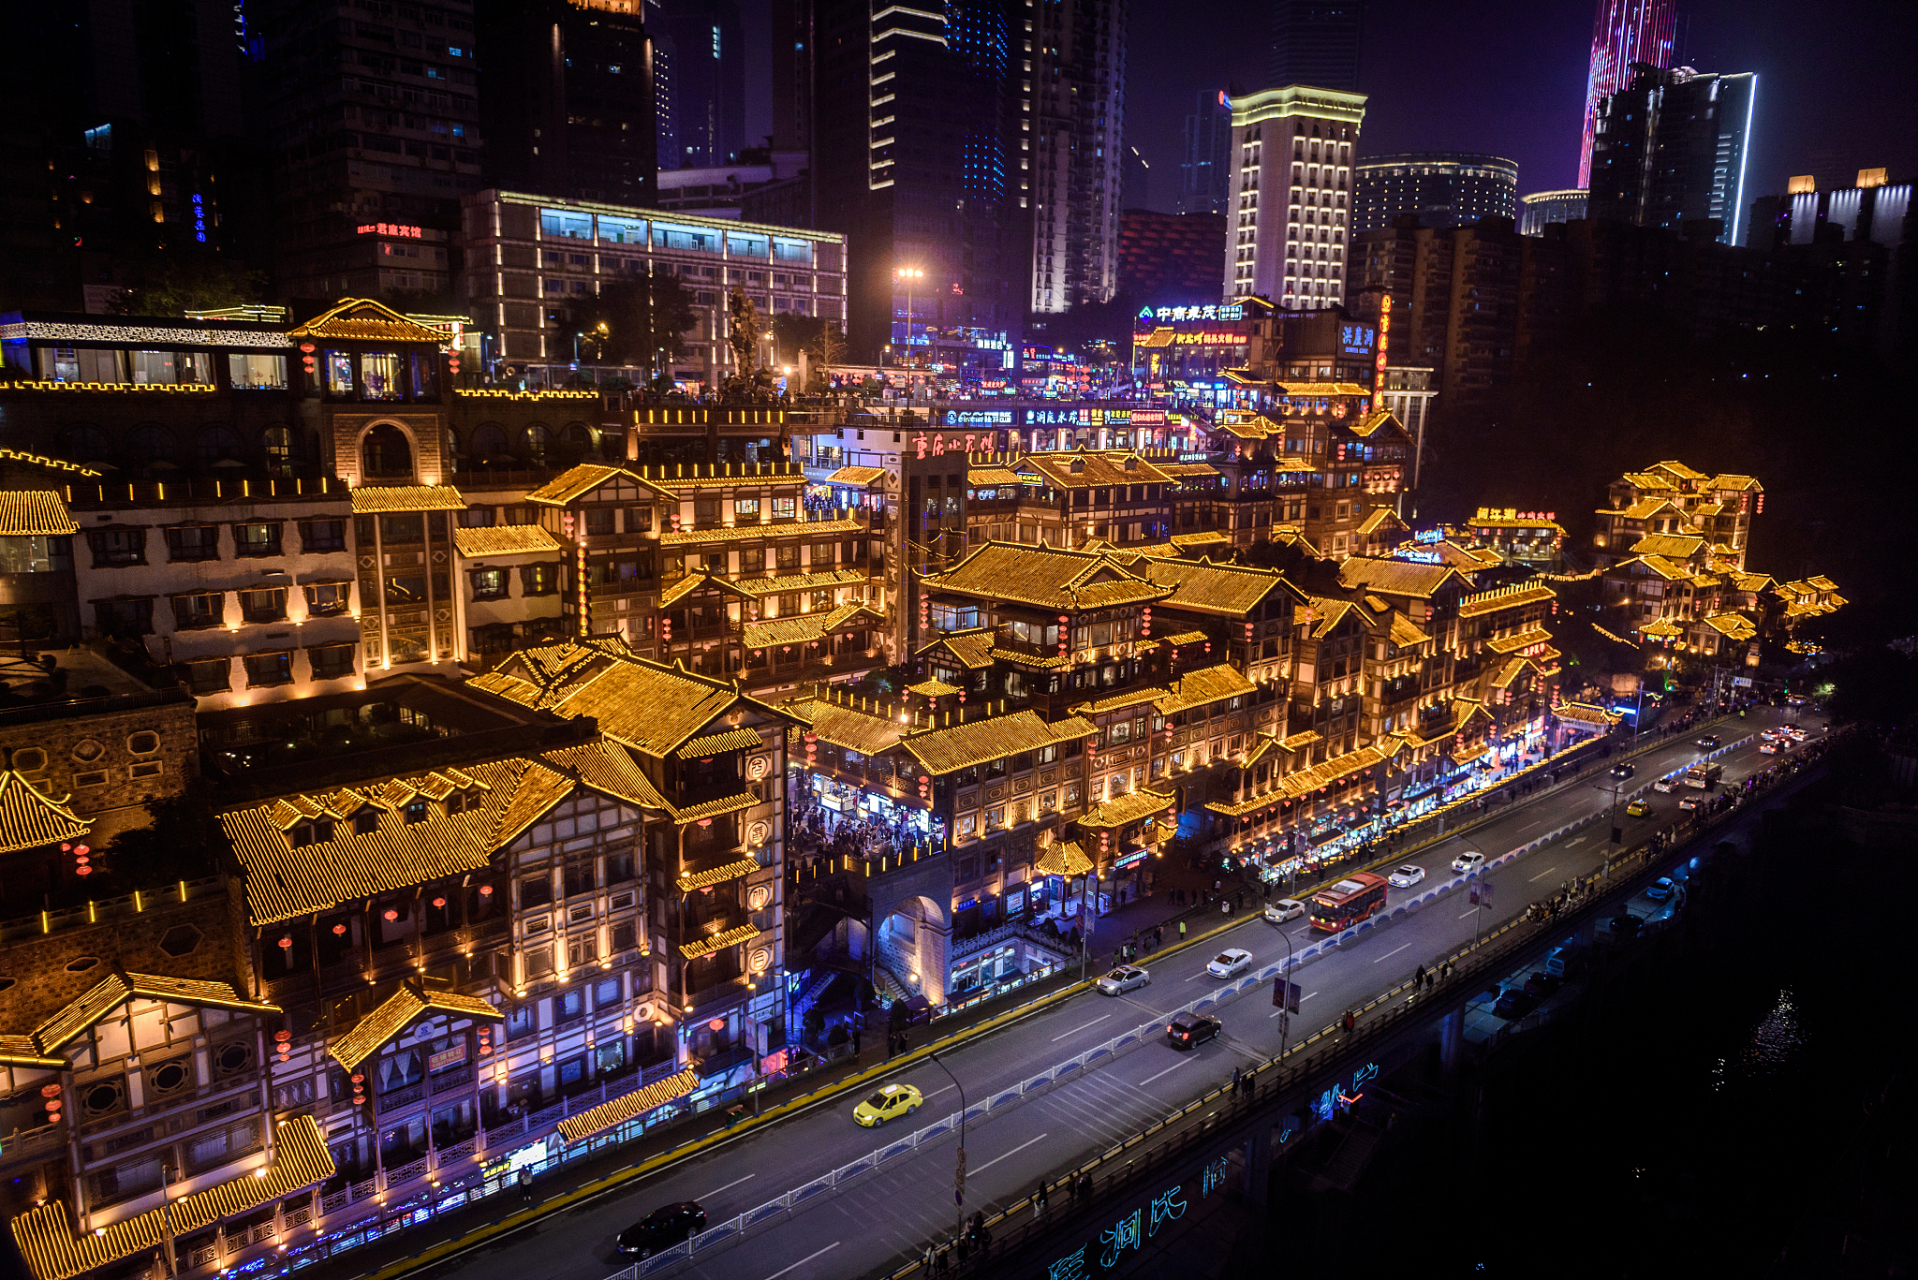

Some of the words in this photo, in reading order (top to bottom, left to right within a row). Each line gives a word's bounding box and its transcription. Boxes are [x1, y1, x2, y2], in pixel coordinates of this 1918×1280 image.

[1342, 326, 1373, 347] 洪崖洞
[912, 431, 995, 460] 重庆小天鹅
